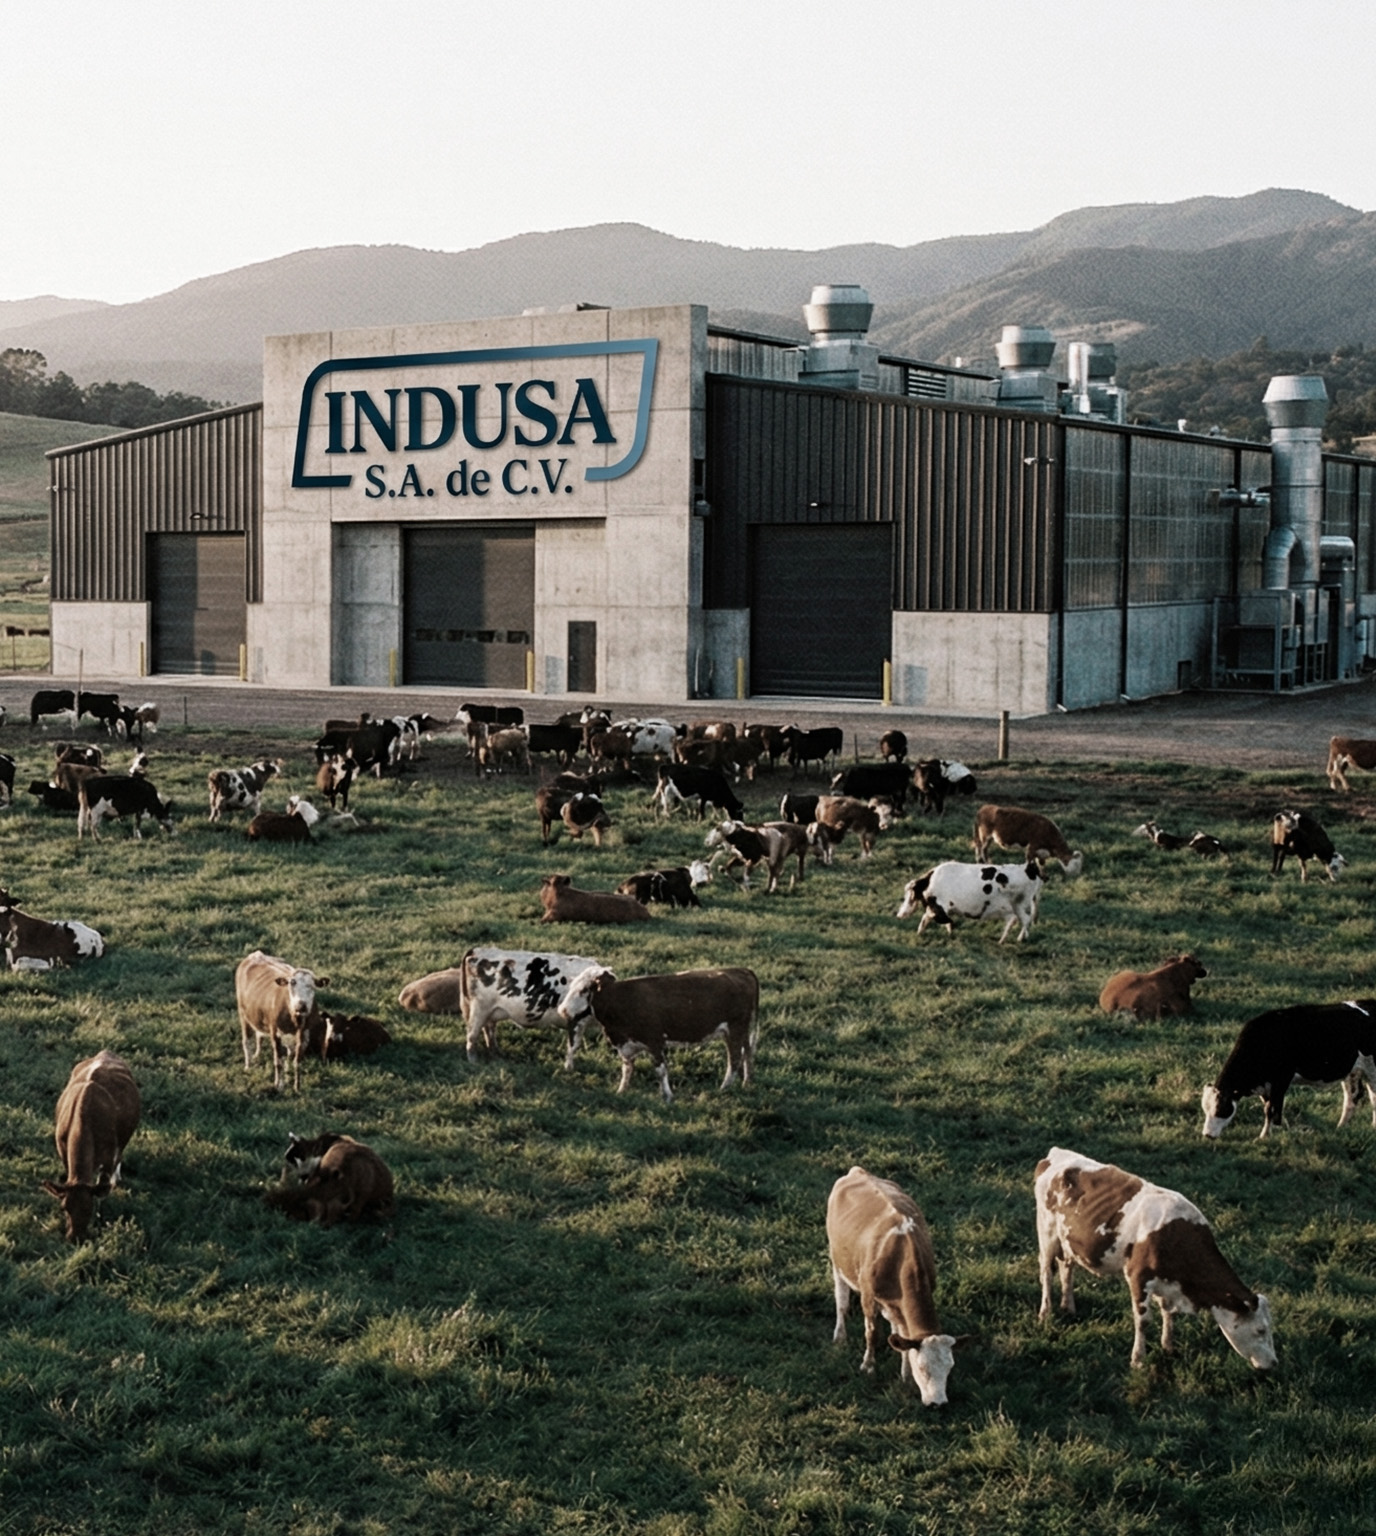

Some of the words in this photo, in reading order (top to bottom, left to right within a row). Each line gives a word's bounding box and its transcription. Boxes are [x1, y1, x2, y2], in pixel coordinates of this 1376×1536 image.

[324, 378, 616, 453] INDUSA
[364, 463, 435, 498] S.A.
[446, 459, 490, 496] de
[502, 458, 573, 495] C.V.
